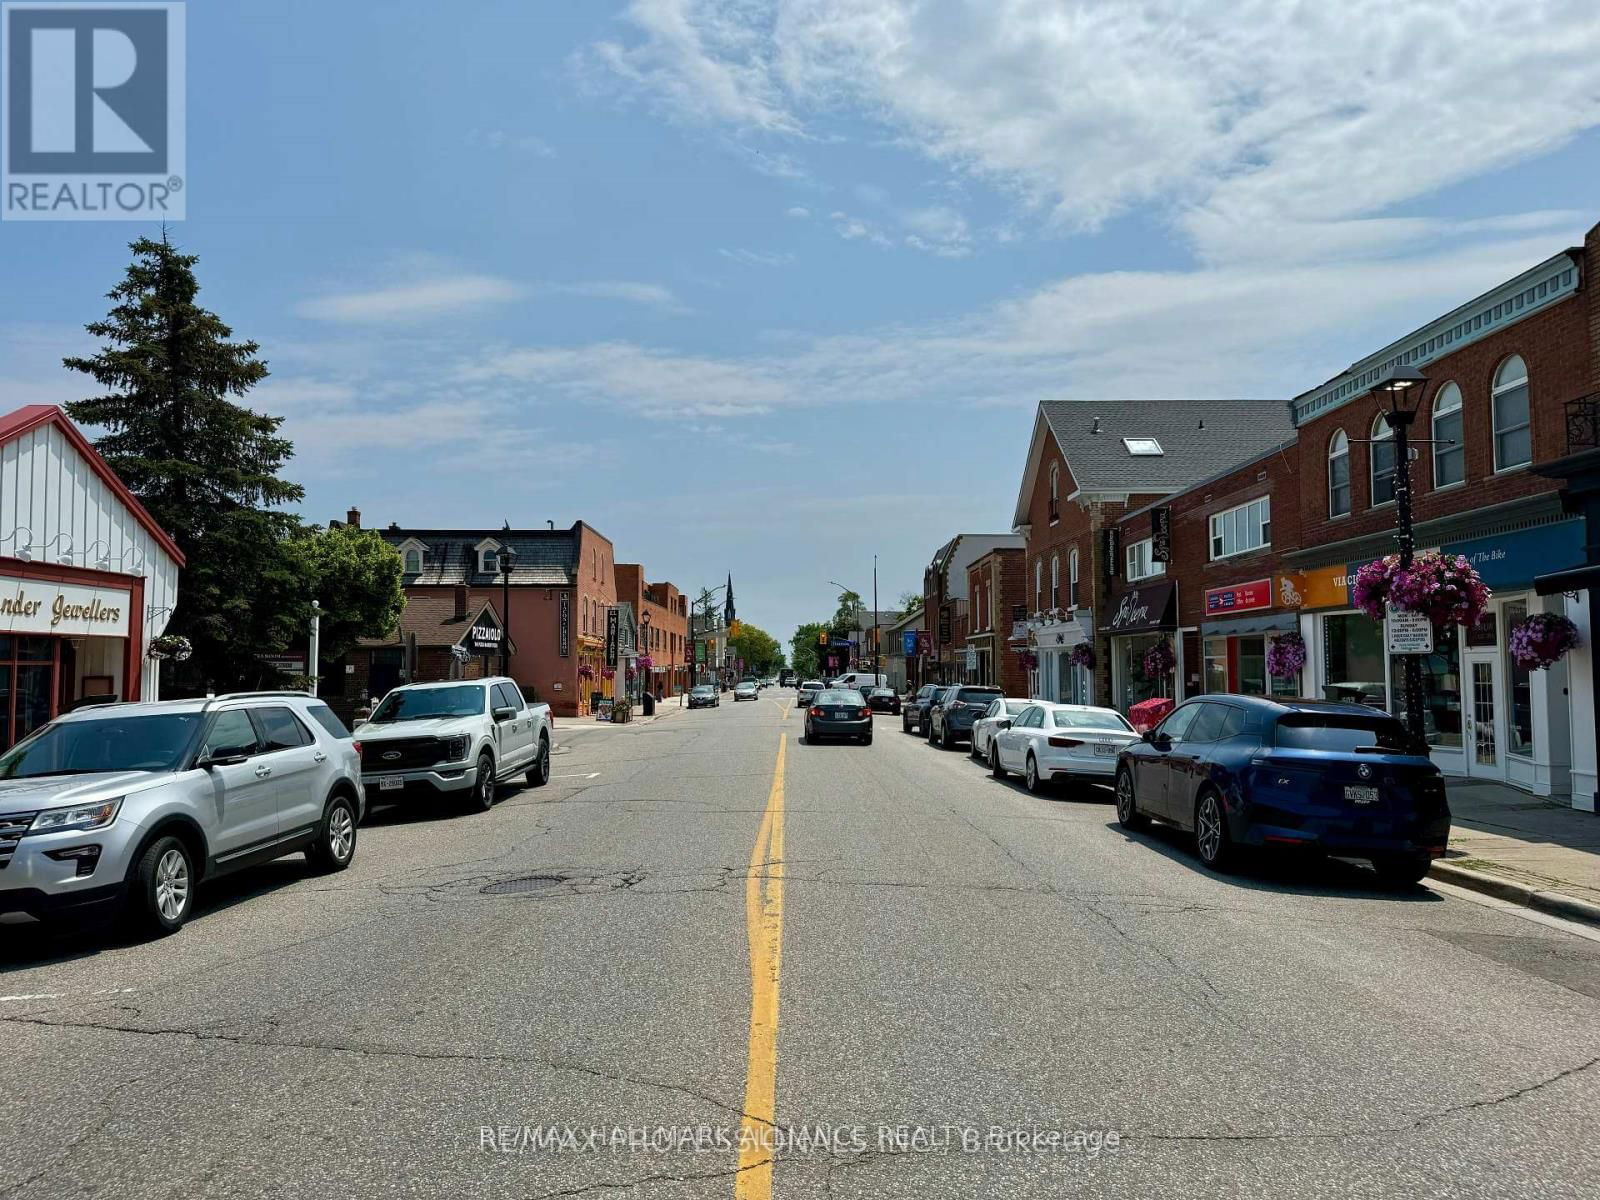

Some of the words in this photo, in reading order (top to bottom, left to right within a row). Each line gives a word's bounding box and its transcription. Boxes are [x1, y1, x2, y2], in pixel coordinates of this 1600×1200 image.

[1469, 553, 1476, 565] of
[1477, 551, 1490, 563] The
[1490, 549, 1506, 561] Bike
[0, 590, 42, 618] nder
[51, 594, 121, 626] Jewellers
[472, 625, 501, 641] PIZZAIOLO
[609, 616, 617, 665] MARIACHI
